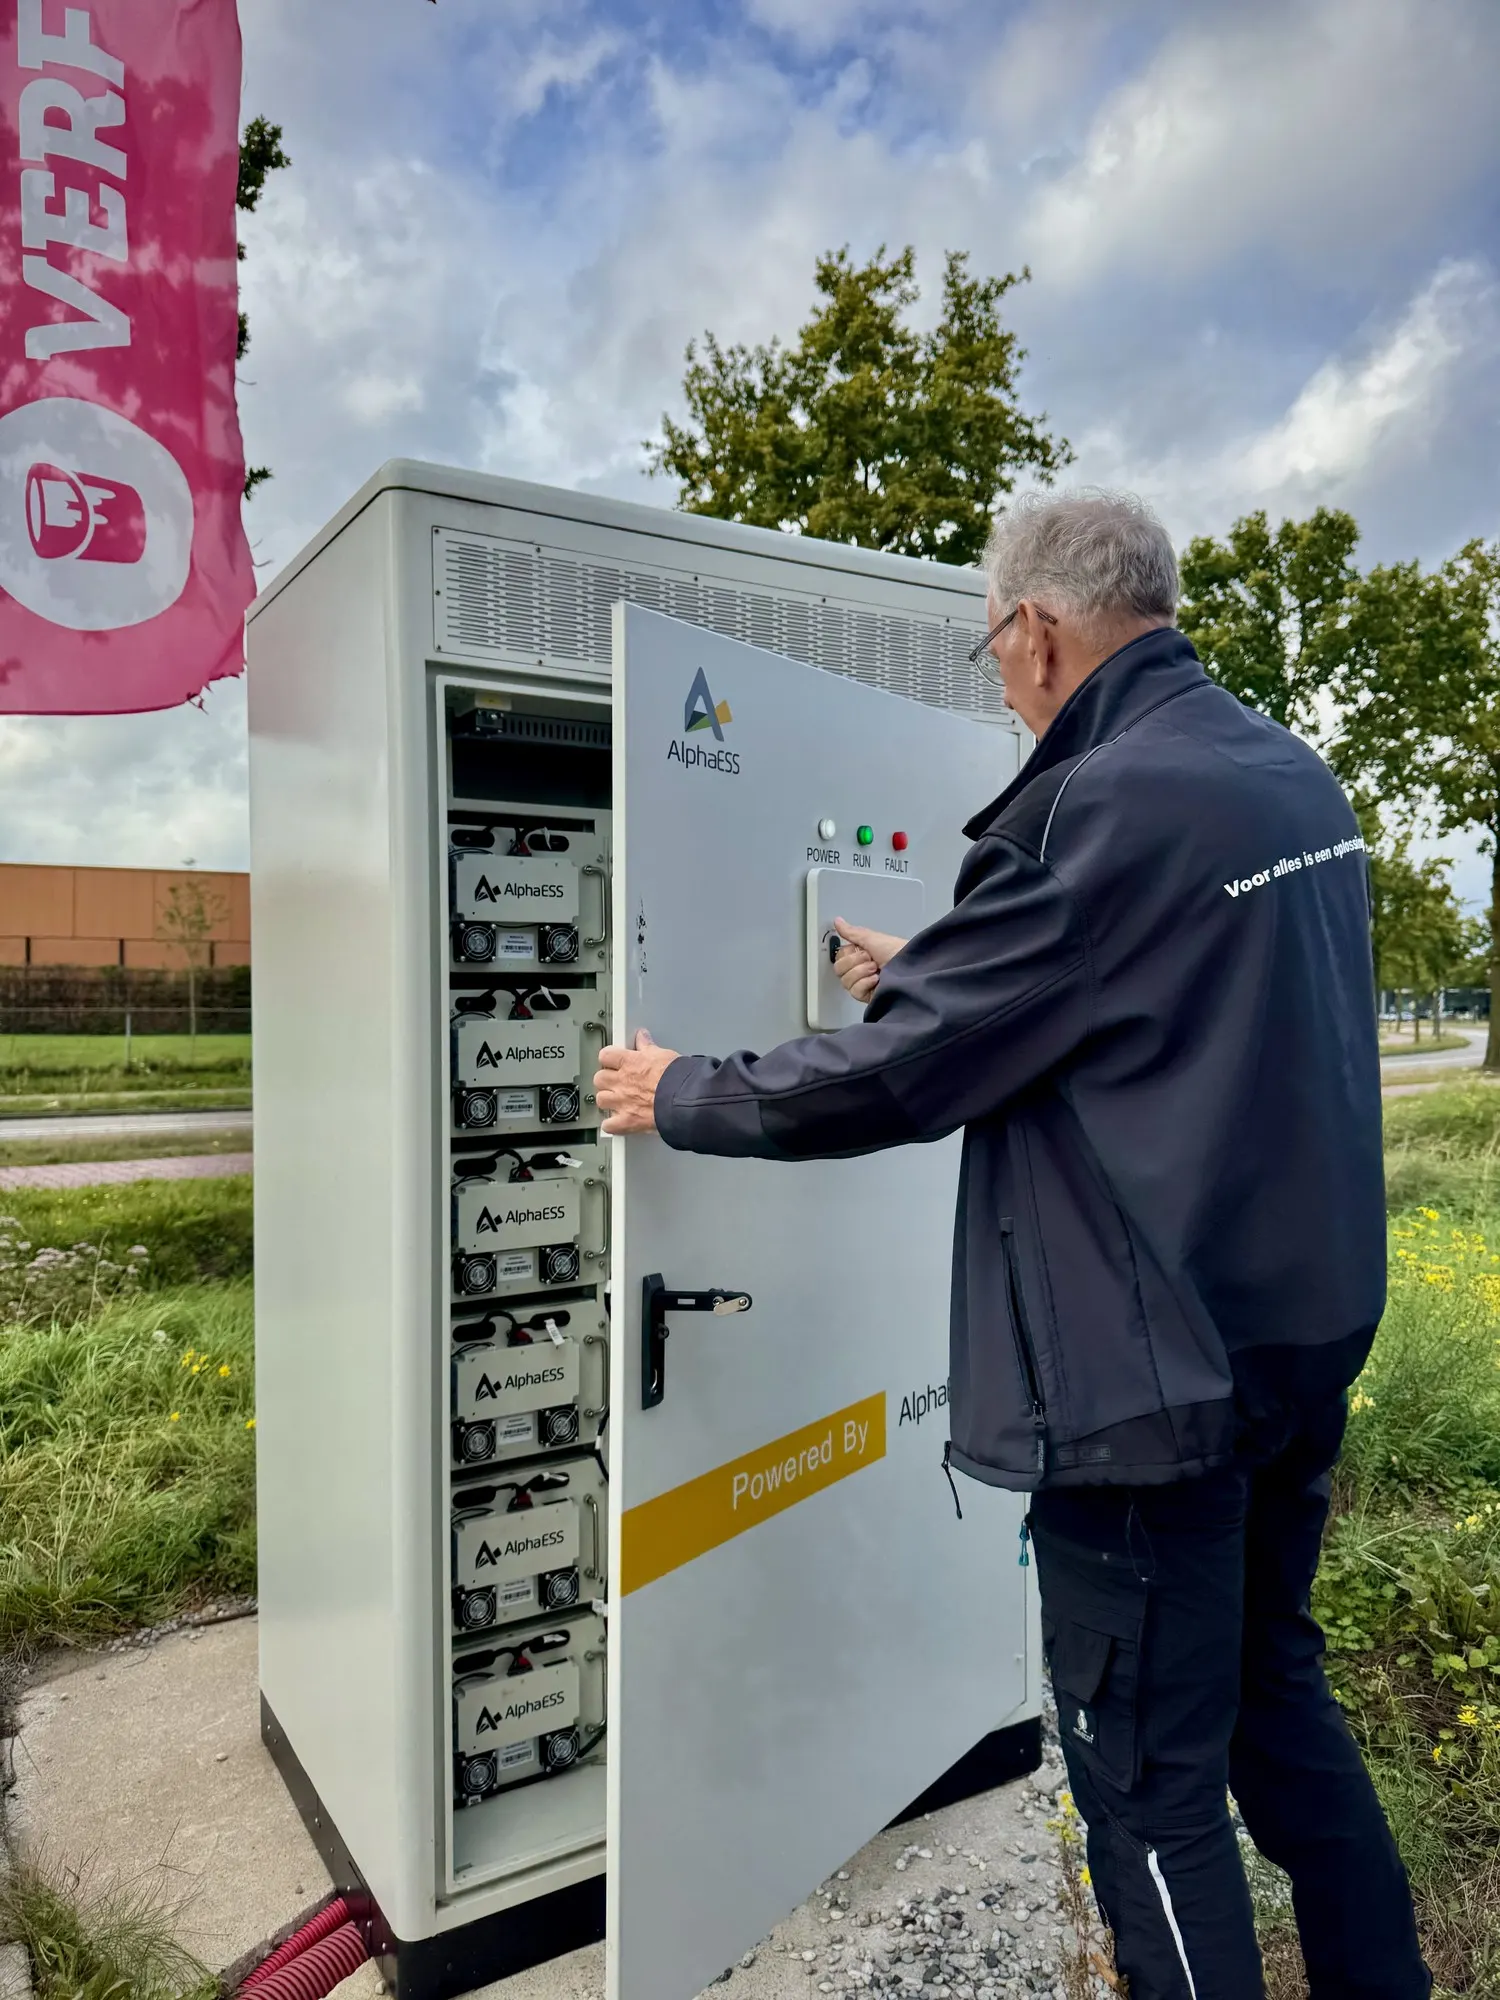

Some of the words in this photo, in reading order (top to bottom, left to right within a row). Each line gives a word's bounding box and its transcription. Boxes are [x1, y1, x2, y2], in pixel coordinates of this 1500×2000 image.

[18, 0, 131, 360] VERF
[667, 740, 740, 775] AlphaESS
[807, 847, 840, 865] POWER
[853, 853, 871, 869] RUN
[885, 857, 908, 874] FAULT
[1223, 868, 1271, 898] Voor
[1273, 857, 1302, 878] alles
[1303, 852, 1314, 867] is
[1314, 847, 1332, 863] een
[504, 882, 564, 899] AlphaESS
[505, 1046, 565, 1063] AlphaESS
[505, 1206, 565, 1226] AlphaESS
[504, 1367, 565, 1390] AlphaESS
[731, 1431, 832, 1511] Powered
[843, 1420, 869, 1455] By
[504, 1530, 565, 1556] AlphaESS
[505, 1691, 565, 1720] AlphaESS
